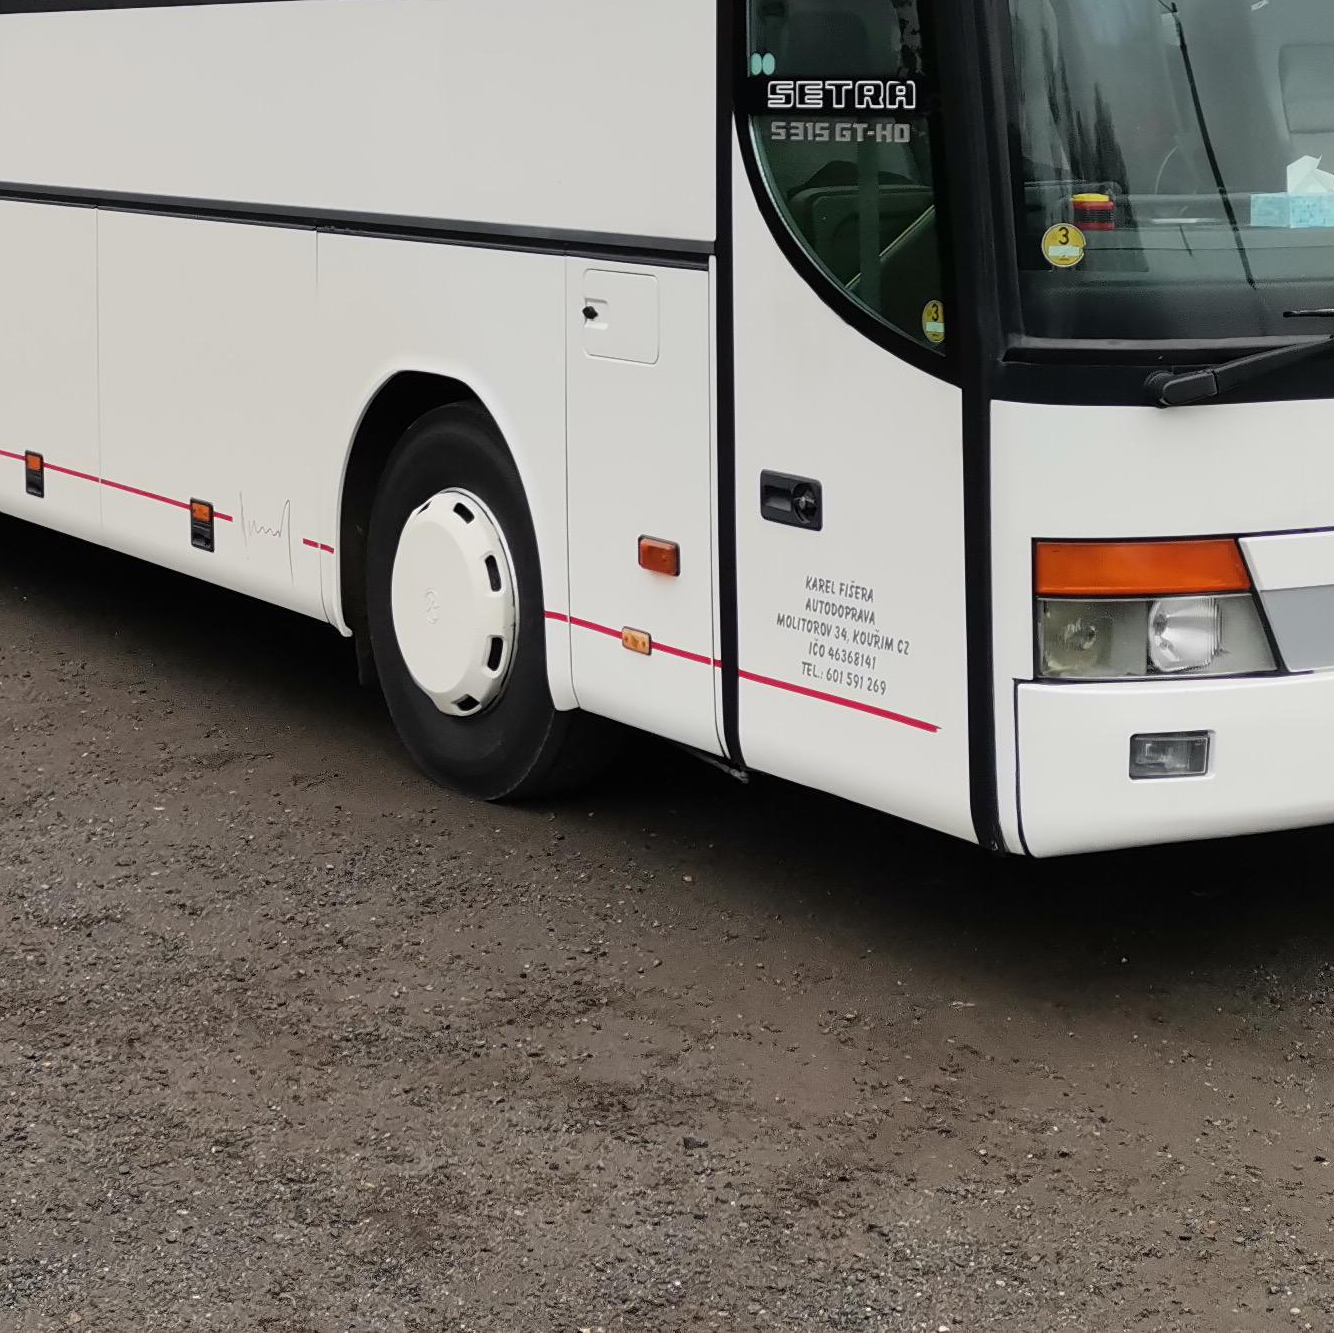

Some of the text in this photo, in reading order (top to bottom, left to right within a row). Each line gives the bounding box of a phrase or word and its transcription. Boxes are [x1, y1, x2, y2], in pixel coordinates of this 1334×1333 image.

[767, 80, 916, 109] SETRA
[834, 122, 911, 143] GT-HD
[1058, 226, 1070, 245] 3
[931, 303, 940, 322] 3
[805, 575, 874, 603] KAREL FIŠERA
[805, 597, 876, 625] AUTODOPRAVA
[776, 612, 910, 655] MOLITOROV 34, KOUŘIM CZ
[808, 638, 877, 671] IČO 46368141
[801, 661, 887, 695] TEL.: 601 591 269
